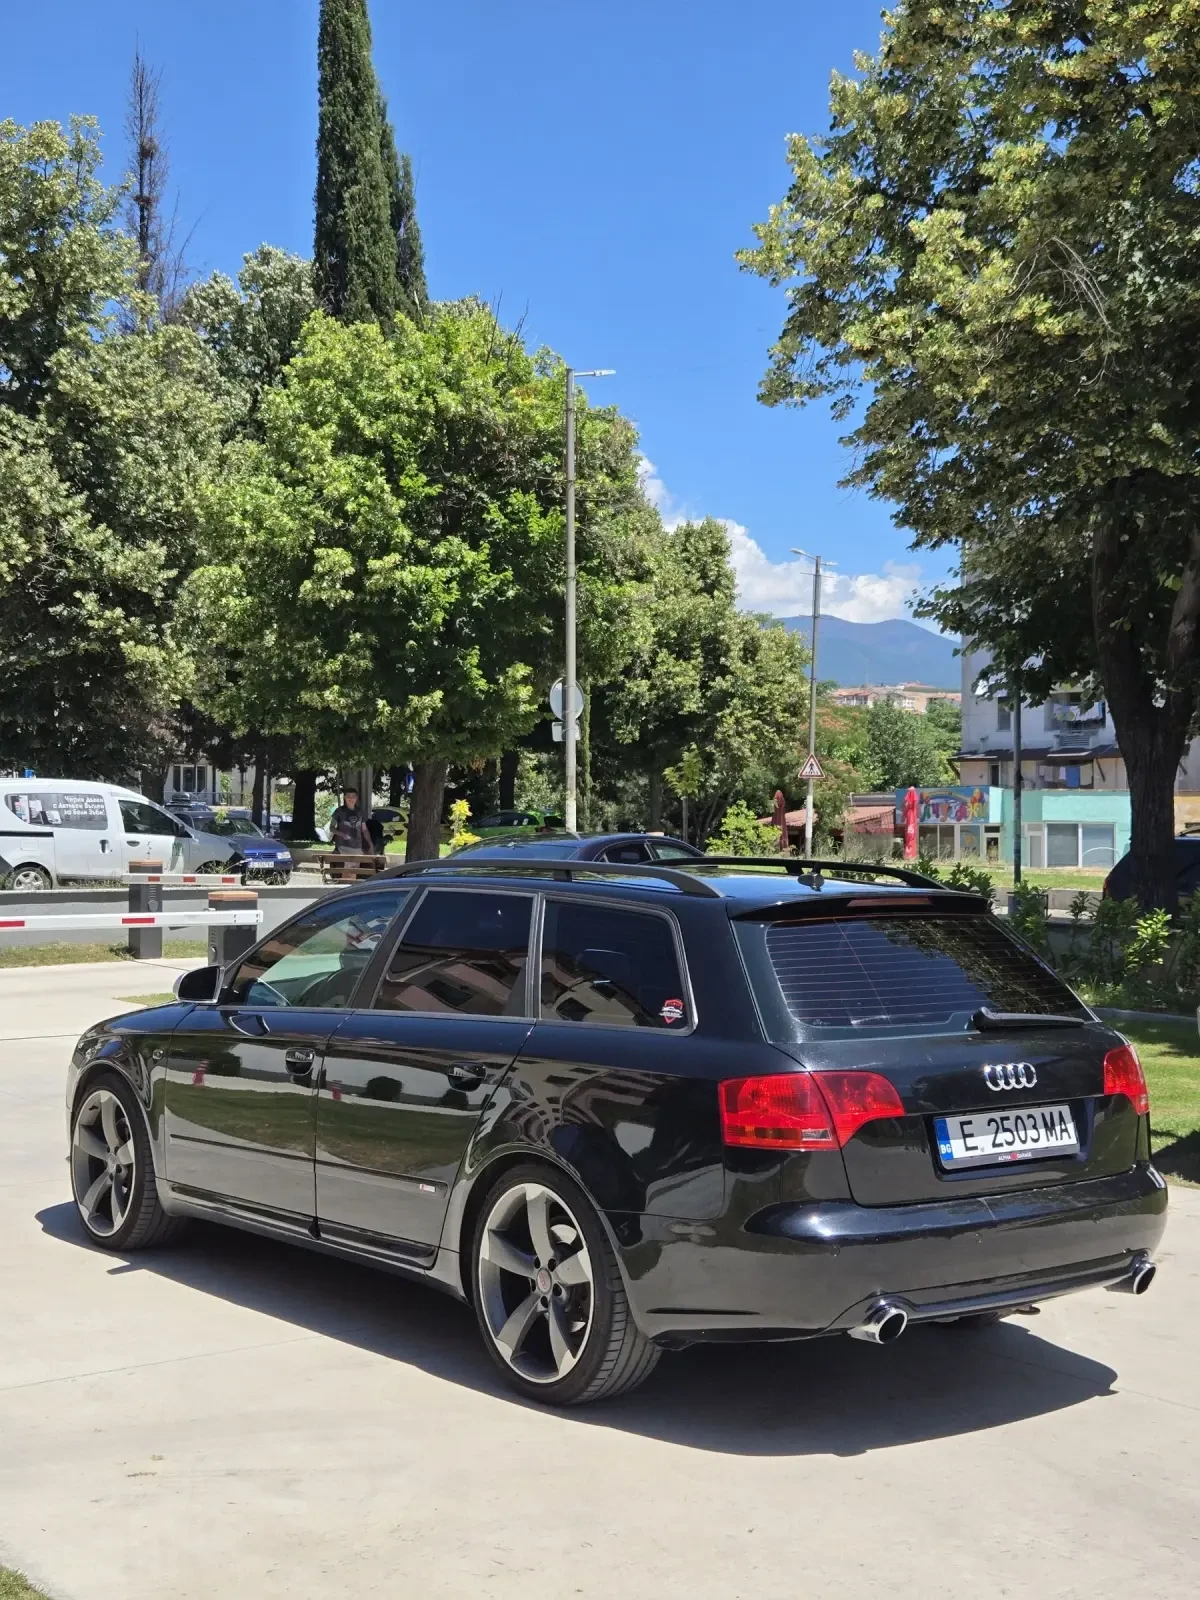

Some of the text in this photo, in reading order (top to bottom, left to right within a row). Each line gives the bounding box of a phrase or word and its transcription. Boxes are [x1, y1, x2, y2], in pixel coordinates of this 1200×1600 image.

[960, 1110, 1072, 1152] E 2503 MA
[940, 1143, 953, 1155] BG
